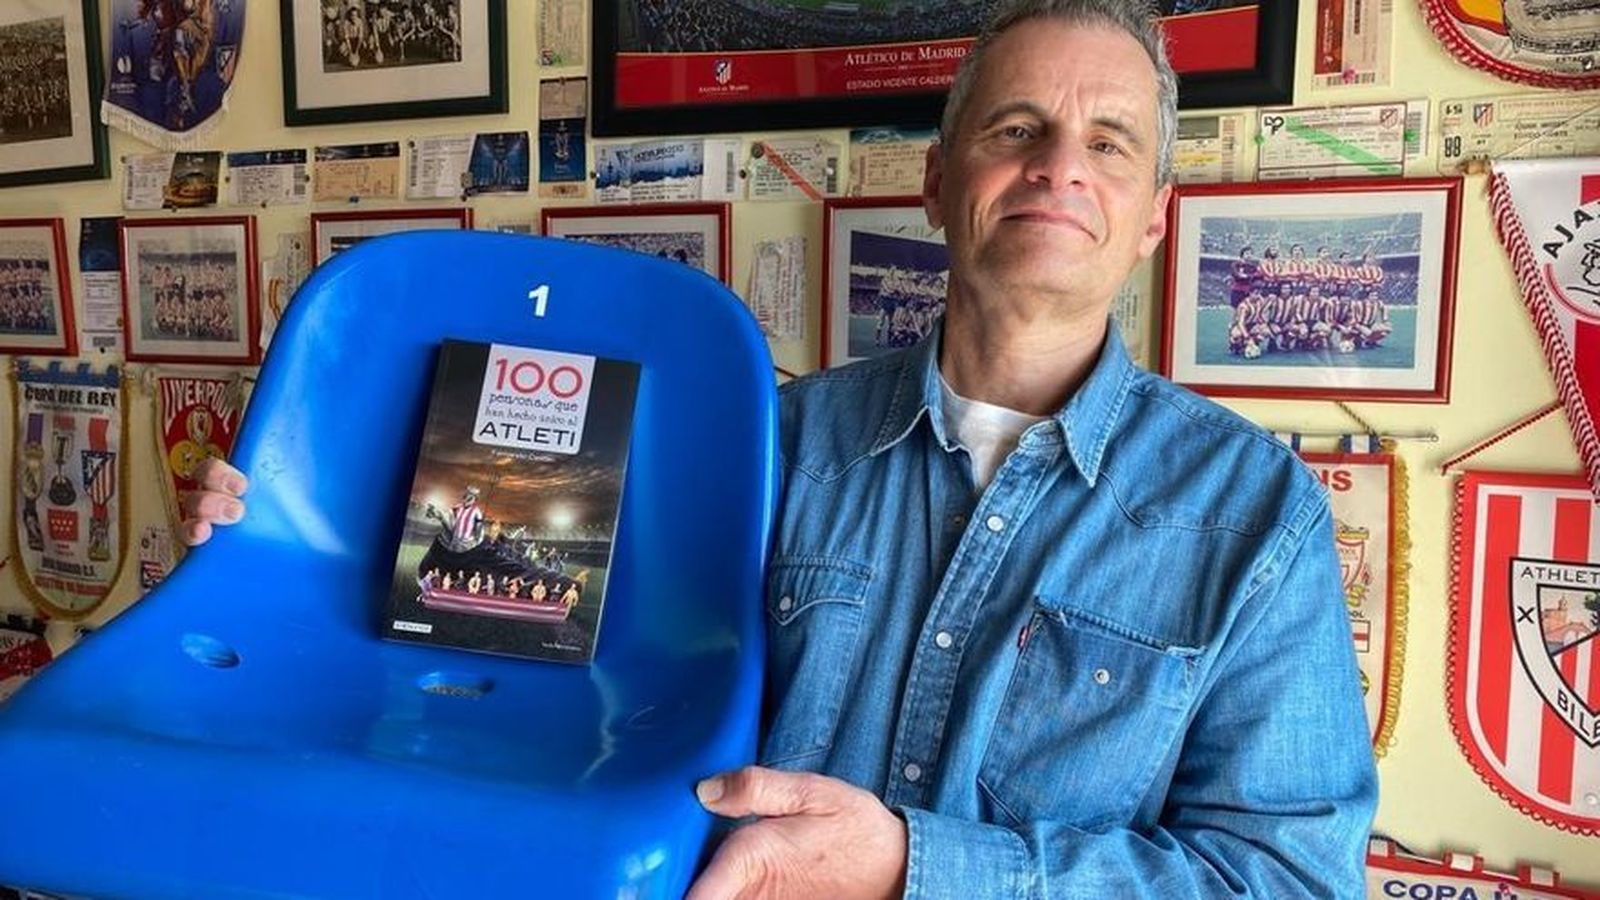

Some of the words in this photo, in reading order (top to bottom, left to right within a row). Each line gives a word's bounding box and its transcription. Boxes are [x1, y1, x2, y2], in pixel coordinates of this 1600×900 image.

[918, 46, 966, 60] MADRID
[1542, 202, 1600, 259] AJA
[528, 284, 549, 317] 1
[496, 358, 583, 398] 100
[87, 391, 117, 407] REY
[488, 393, 553, 409] personas
[555, 401, 578, 413] que
[479, 421, 576, 447] ATLETI
[1521, 565, 1600, 585] ATHLET
[1383, 879, 1478, 900] COPA
